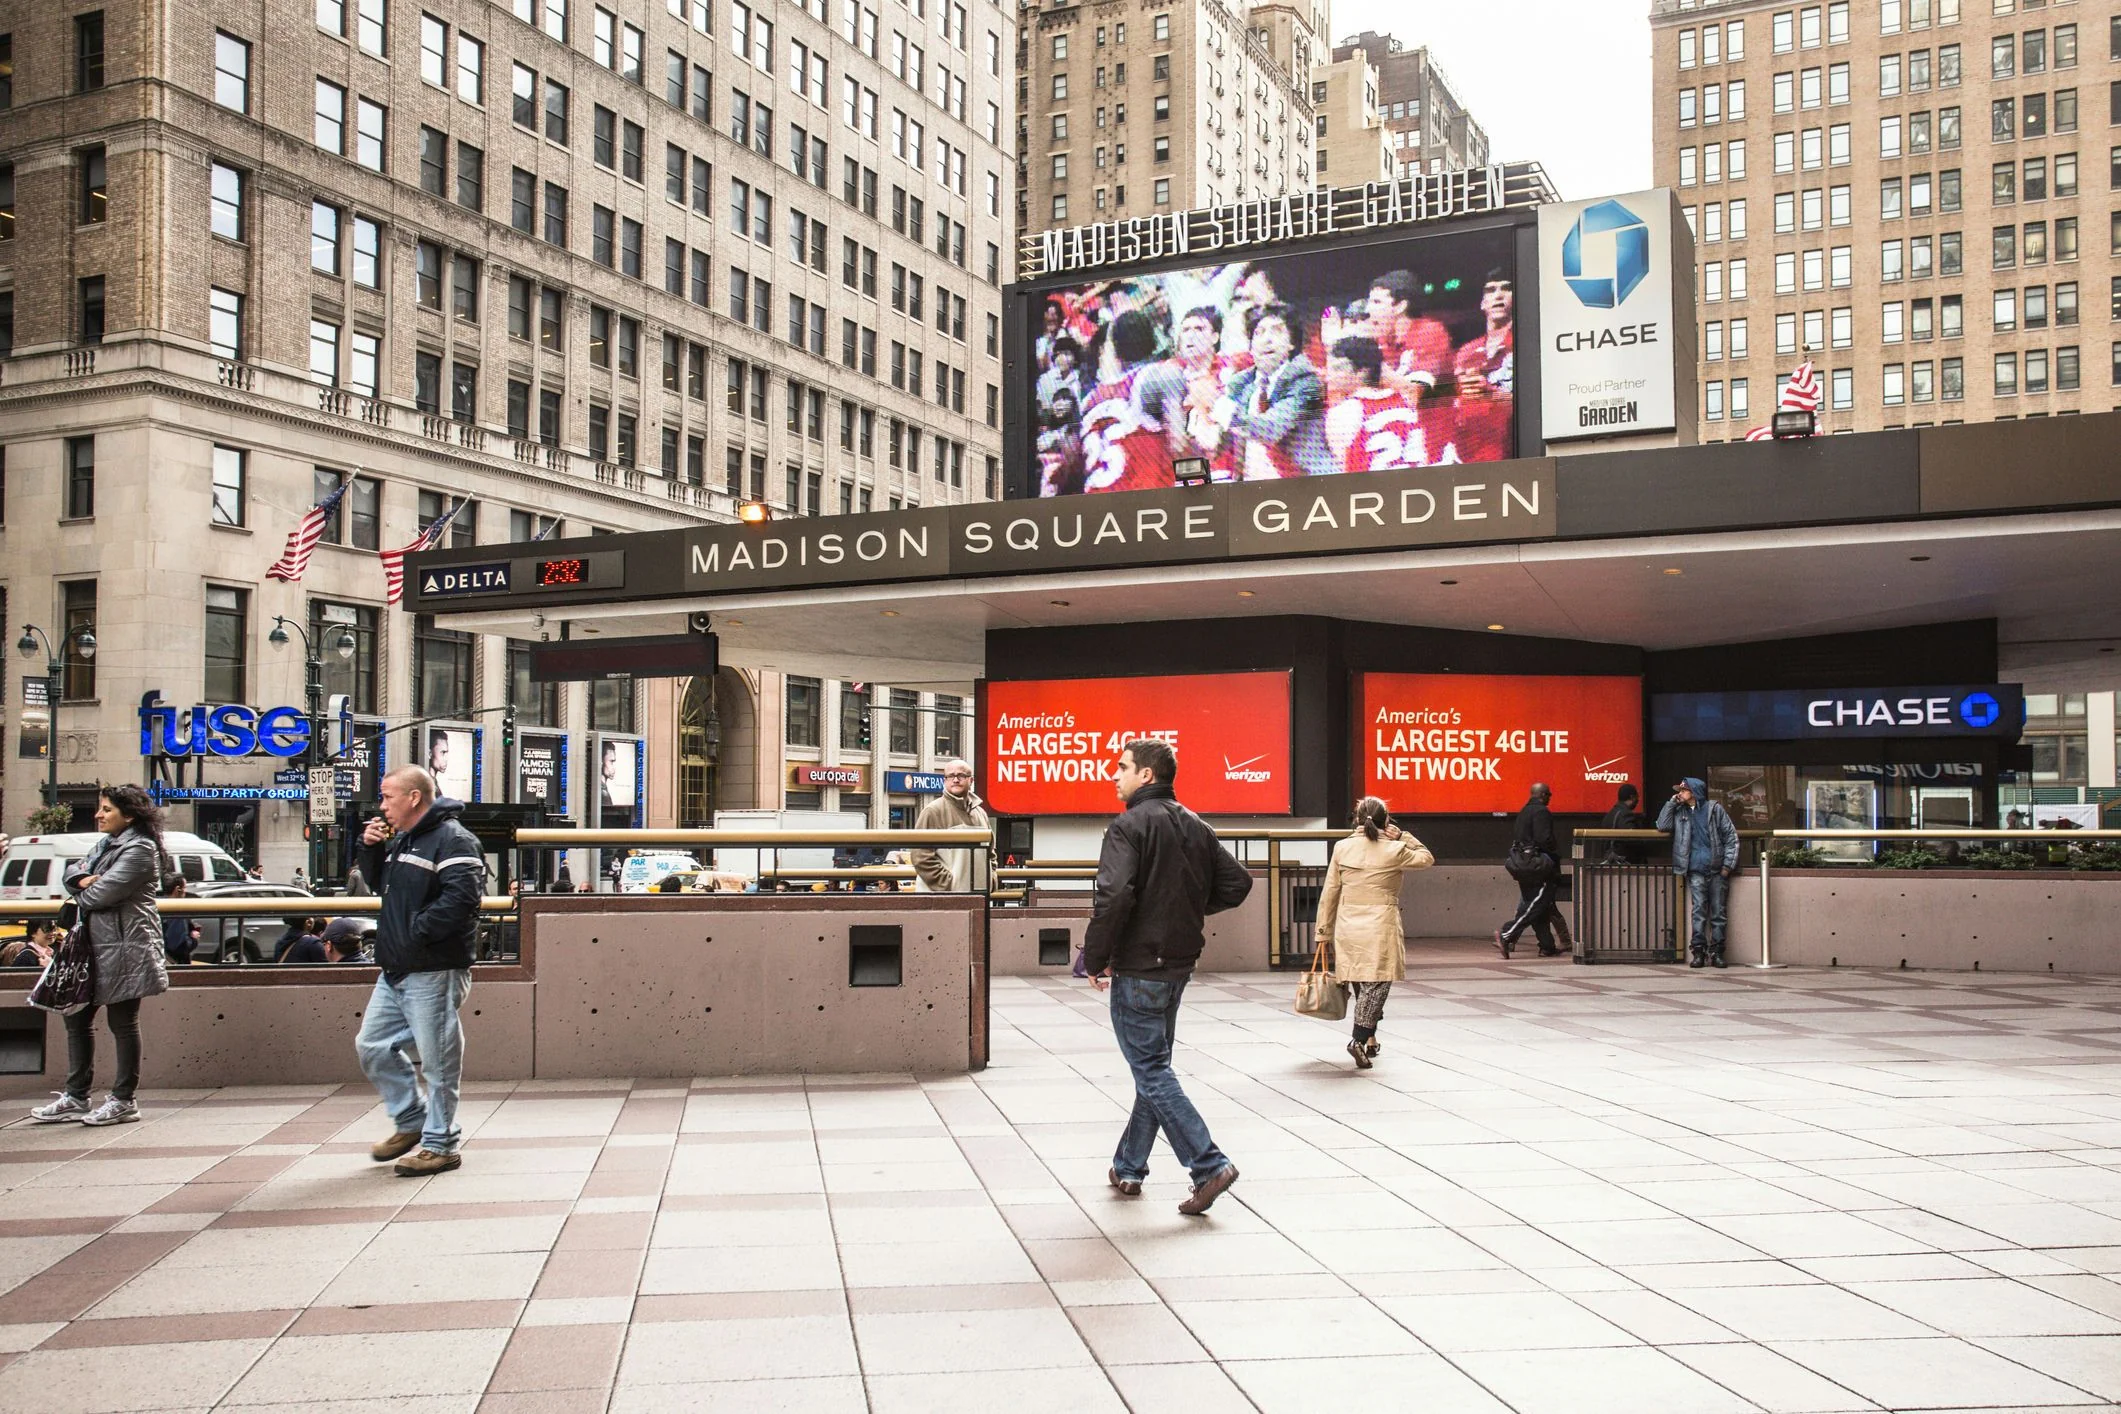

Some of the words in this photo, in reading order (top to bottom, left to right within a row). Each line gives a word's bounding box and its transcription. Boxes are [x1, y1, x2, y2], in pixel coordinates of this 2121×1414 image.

[1042, 209, 1189, 273] MADISON
[1209, 187, 1340, 248] SQUARE
[1362, 163, 1506, 229] GARDEN
[1555, 322, 1658, 353] CHASE
[1568, 381, 1602, 395] Proud
[1604, 378, 1647, 392] Partner
[1578, 401, 1638, 427] GARDEN
[691, 526, 928, 574] MADISON
[964, 504, 1215, 554] SQUARE
[1252, 480, 1540, 534] GARDEN
[444, 570, 507, 590] DELTA
[544, 559, 581, 585] 2:32
[997, 711, 1075, 729] America's
[1375, 707, 1461, 725] America's
[1807, 697, 1952, 727] CHASE
[138, 690, 312, 757] fuse
[998, 732, 1102, 756] LARGEST
[1376, 729, 1490, 753] LARGEST
[1494, 729, 1526, 753] 4G
[1530, 730, 1569, 753] LTE
[519, 759, 555, 768] ALMOST
[521, 767, 554, 776] HUMAN
[997, 759, 1112, 782] NETWORK
[1376, 757, 1502, 781] NETWORK
[311, 770, 333, 784] STOP
[809, 770, 846, 785] europa
[847, 769, 860, 783] café
[1225, 769, 1271, 783] verizon
[1584, 770, 1629, 783] verizon
[191, 789, 220, 799] WILD
[222, 789, 265, 799] PARTY
[267, 789, 309, 800] GROUP
[312, 786, 324, 795] HERE
[326, 785, 333, 794] ON
[317, 797, 328, 806] RED
[312, 808, 333, 818] SIGNAL
[630, 858, 646, 866] PAR
[656, 862, 670, 871] PAR
